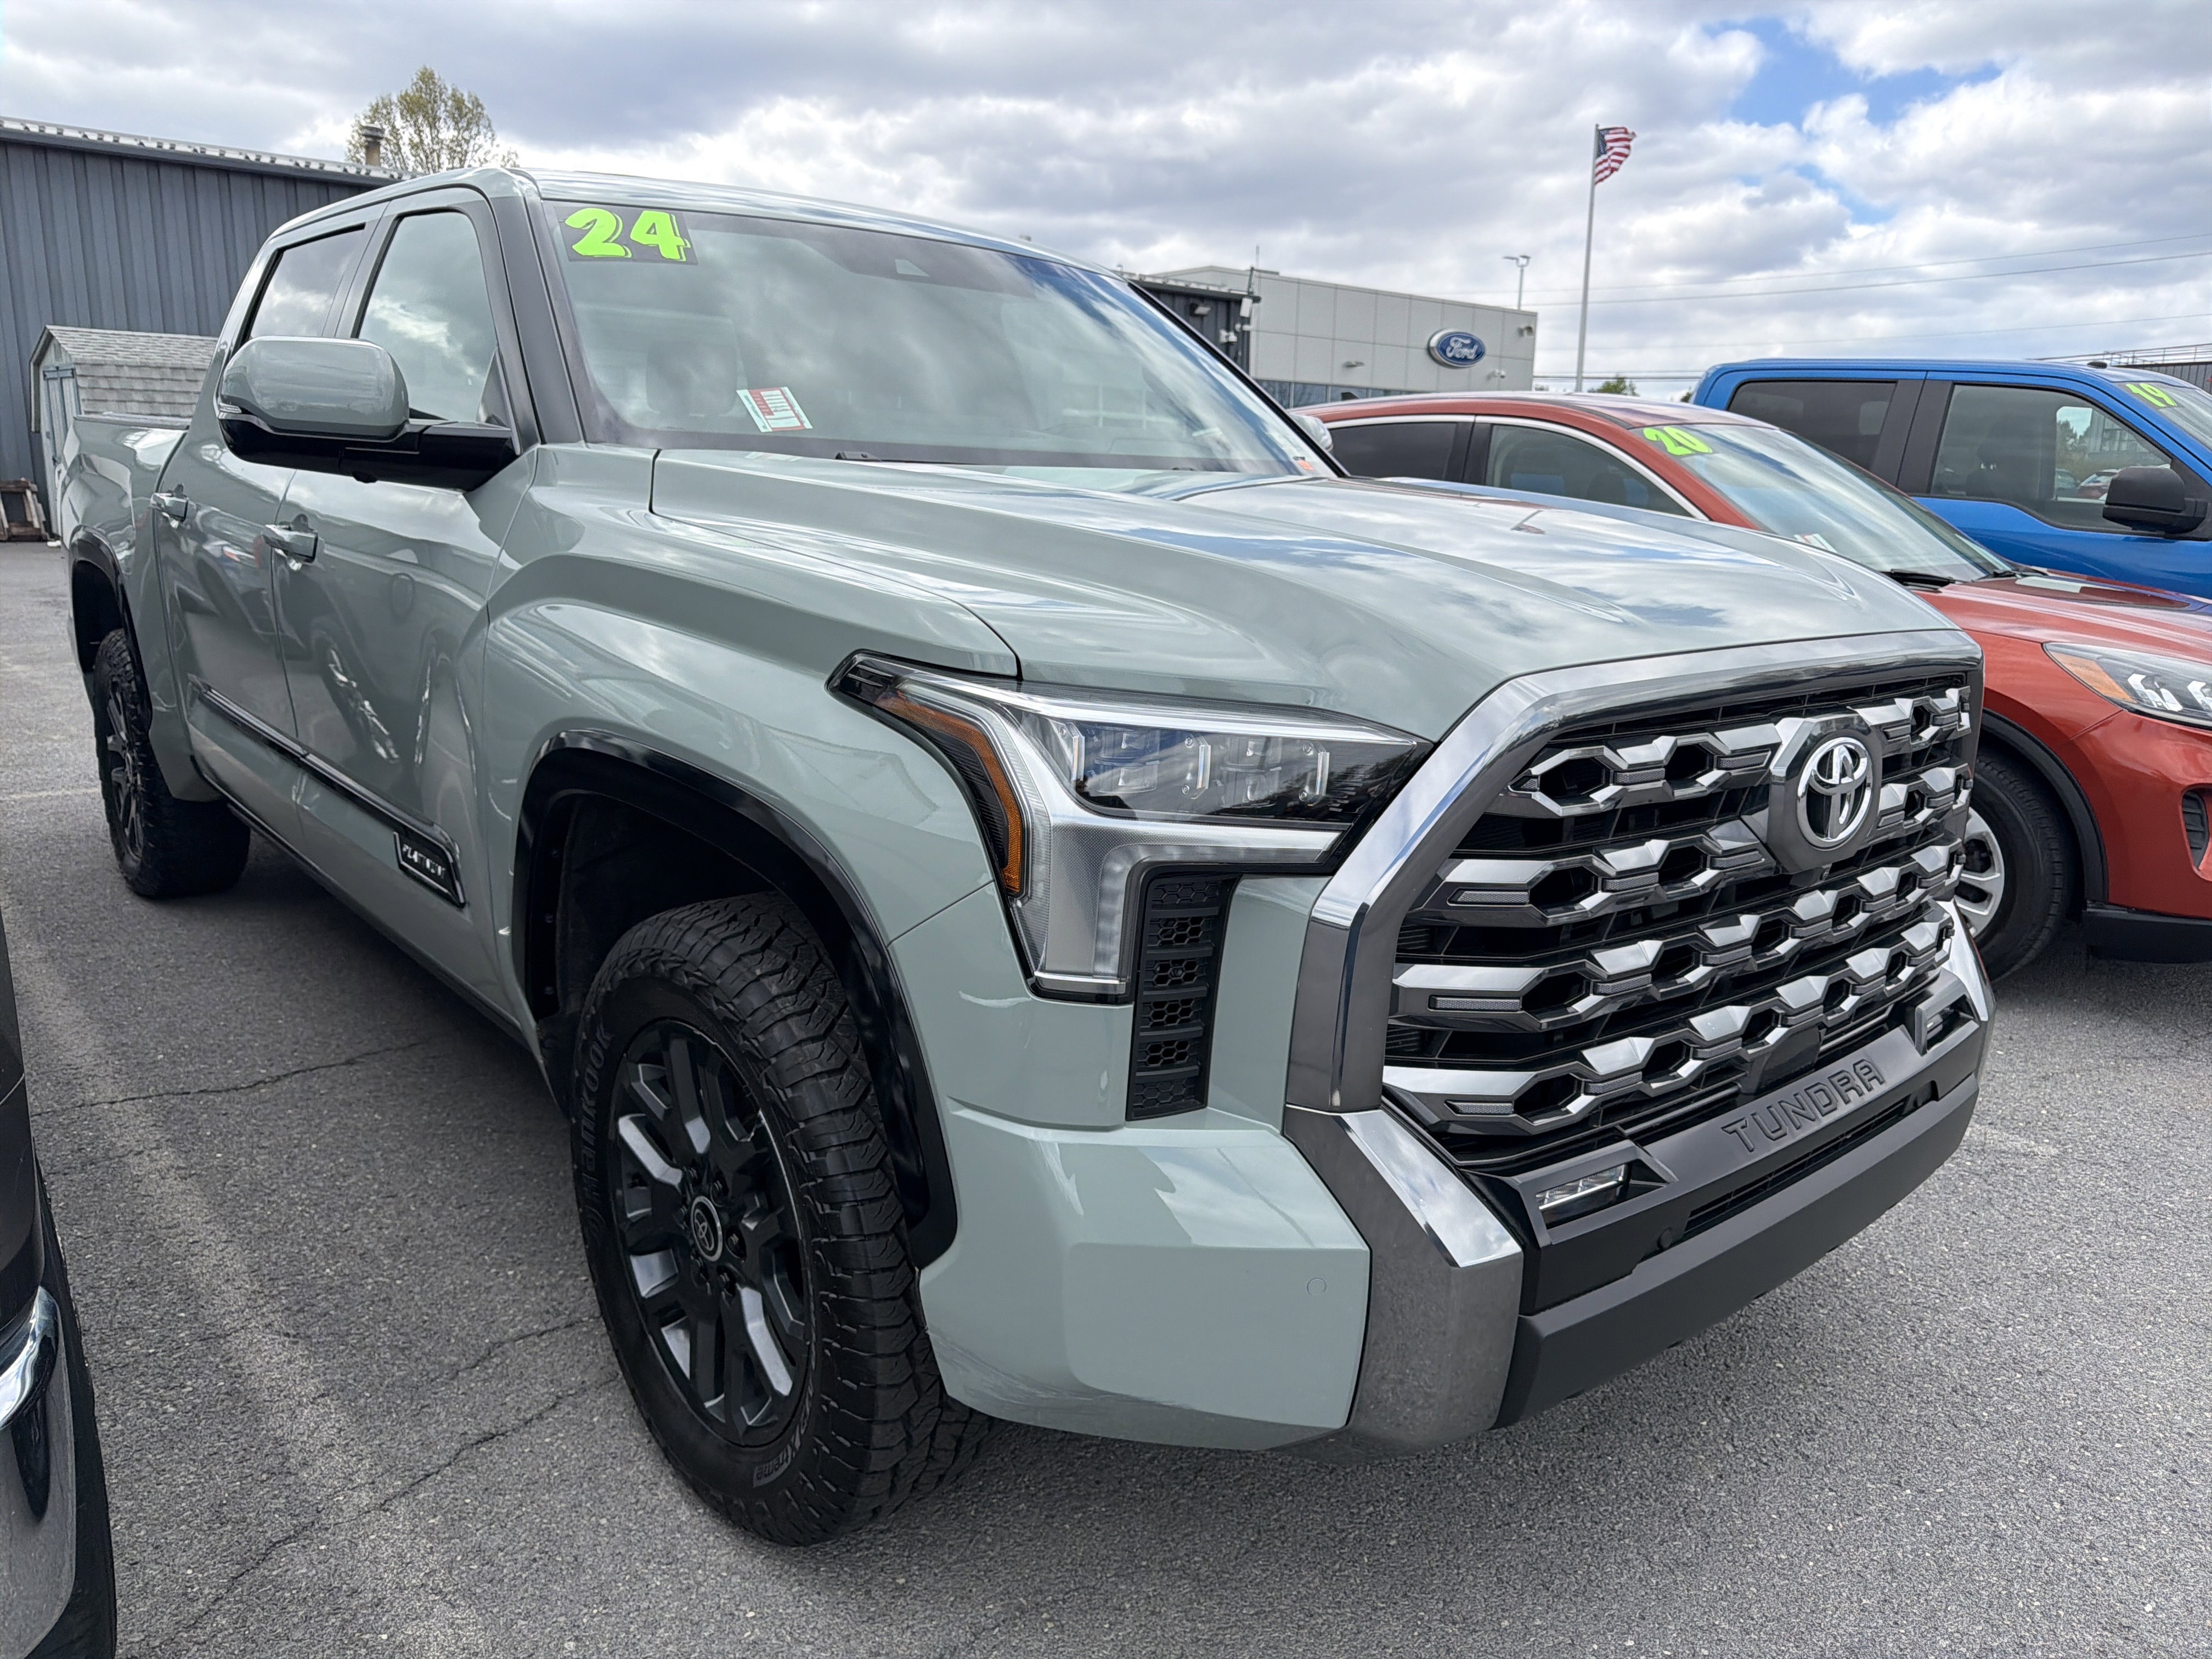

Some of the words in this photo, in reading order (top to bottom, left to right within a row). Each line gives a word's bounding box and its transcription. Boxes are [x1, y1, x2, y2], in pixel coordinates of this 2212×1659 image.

[565, 207, 690, 262] 24
[1446, 336, 1478, 359] Ford
[2125, 383, 2177, 407] 19
[1643, 426, 1713, 456] 20
[1721, 1058, 1885, 1153] TUNDRA
